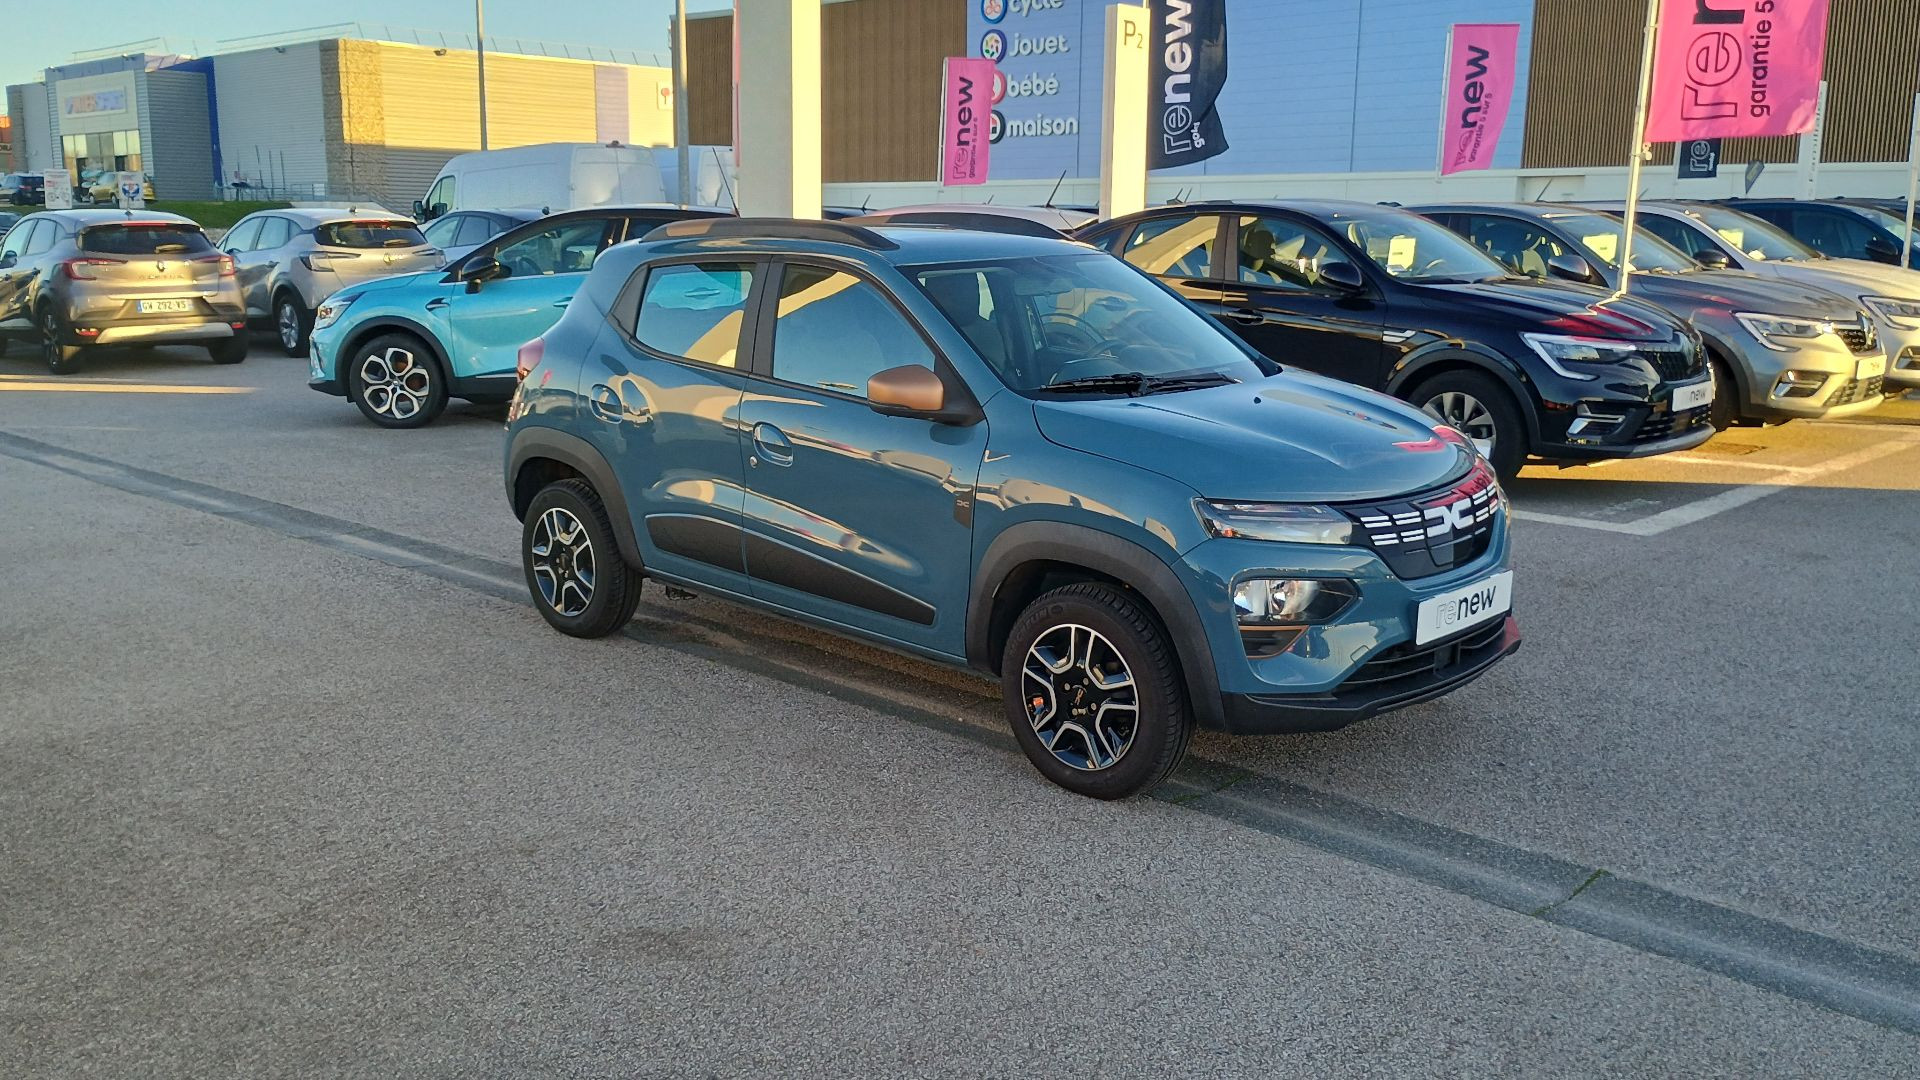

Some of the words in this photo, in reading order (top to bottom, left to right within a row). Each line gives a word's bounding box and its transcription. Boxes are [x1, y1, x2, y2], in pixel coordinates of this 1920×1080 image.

[1755, 0, 1774, 13] 5
[1009, 33, 1070, 57] jouet
[1007, 72, 1059, 97] bébé
[1163, 0, 1192, 155] renew
[1750, 19, 1773, 118] garantie
[1007, 113, 1079, 137] maison
[1453, 45, 1490, 167] renew
[953, 76, 973, 179] renew
[1467, 123, 1484, 163] garantie
[1435, 585, 1497, 629] renew
